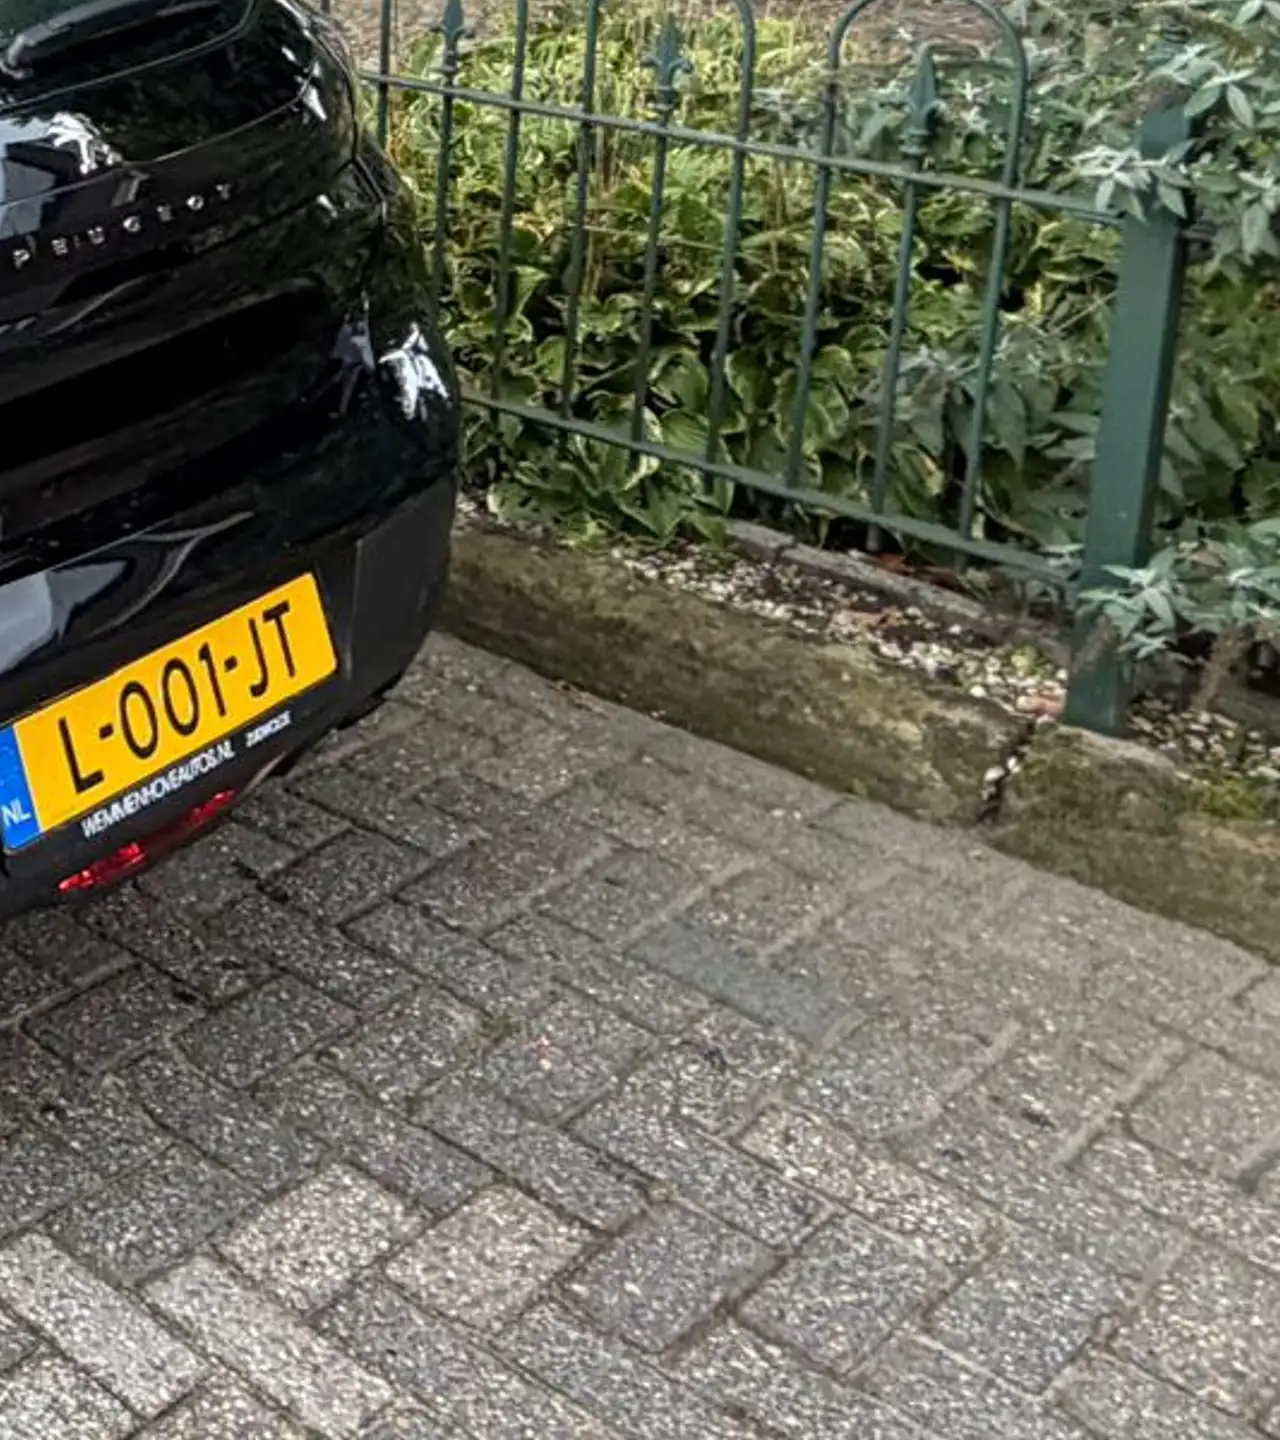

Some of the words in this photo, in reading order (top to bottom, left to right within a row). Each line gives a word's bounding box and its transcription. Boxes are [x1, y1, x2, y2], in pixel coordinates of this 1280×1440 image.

[12, 182, 233, 270] PEUGEOT
[57, 600, 297, 795] L-001-JT
[0, 797, 32, 827] NL
[79, 739, 236, 839] WEMMENHOVEAUTOS.NL
